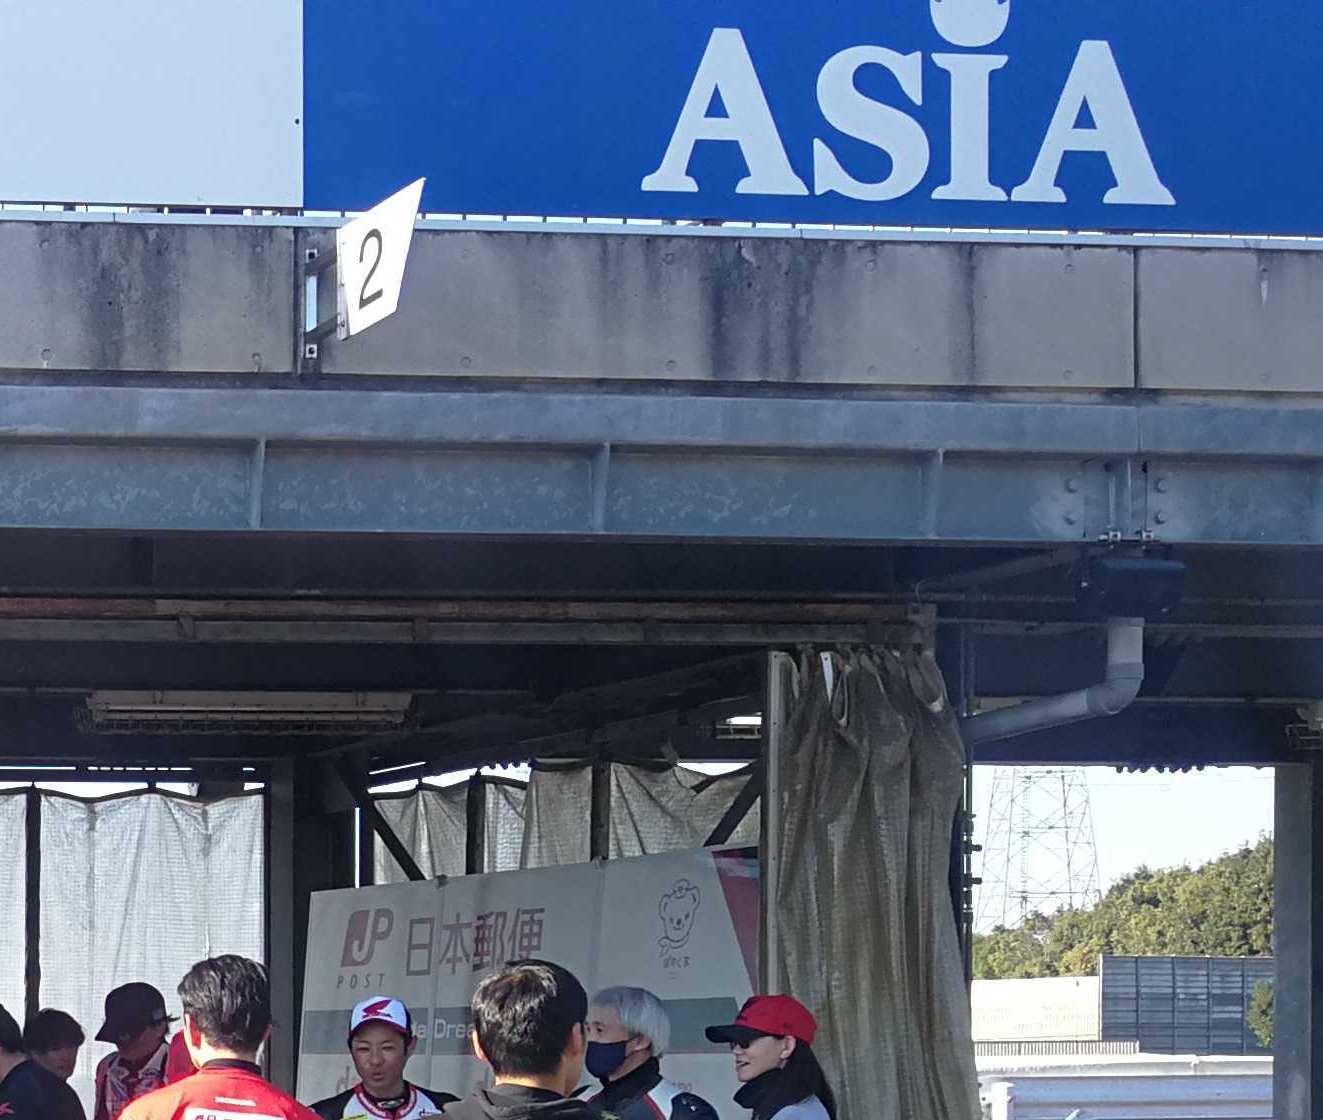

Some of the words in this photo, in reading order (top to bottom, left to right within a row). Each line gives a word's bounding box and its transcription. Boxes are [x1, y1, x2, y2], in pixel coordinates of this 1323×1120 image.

[642, 28, 1175, 205] ASIA
[357, 227, 384, 310] 2
[406, 907, 546, 976] 日本郵便
[334, 973, 385, 988] POST
[434, 1018, 473, 1039] Drea
